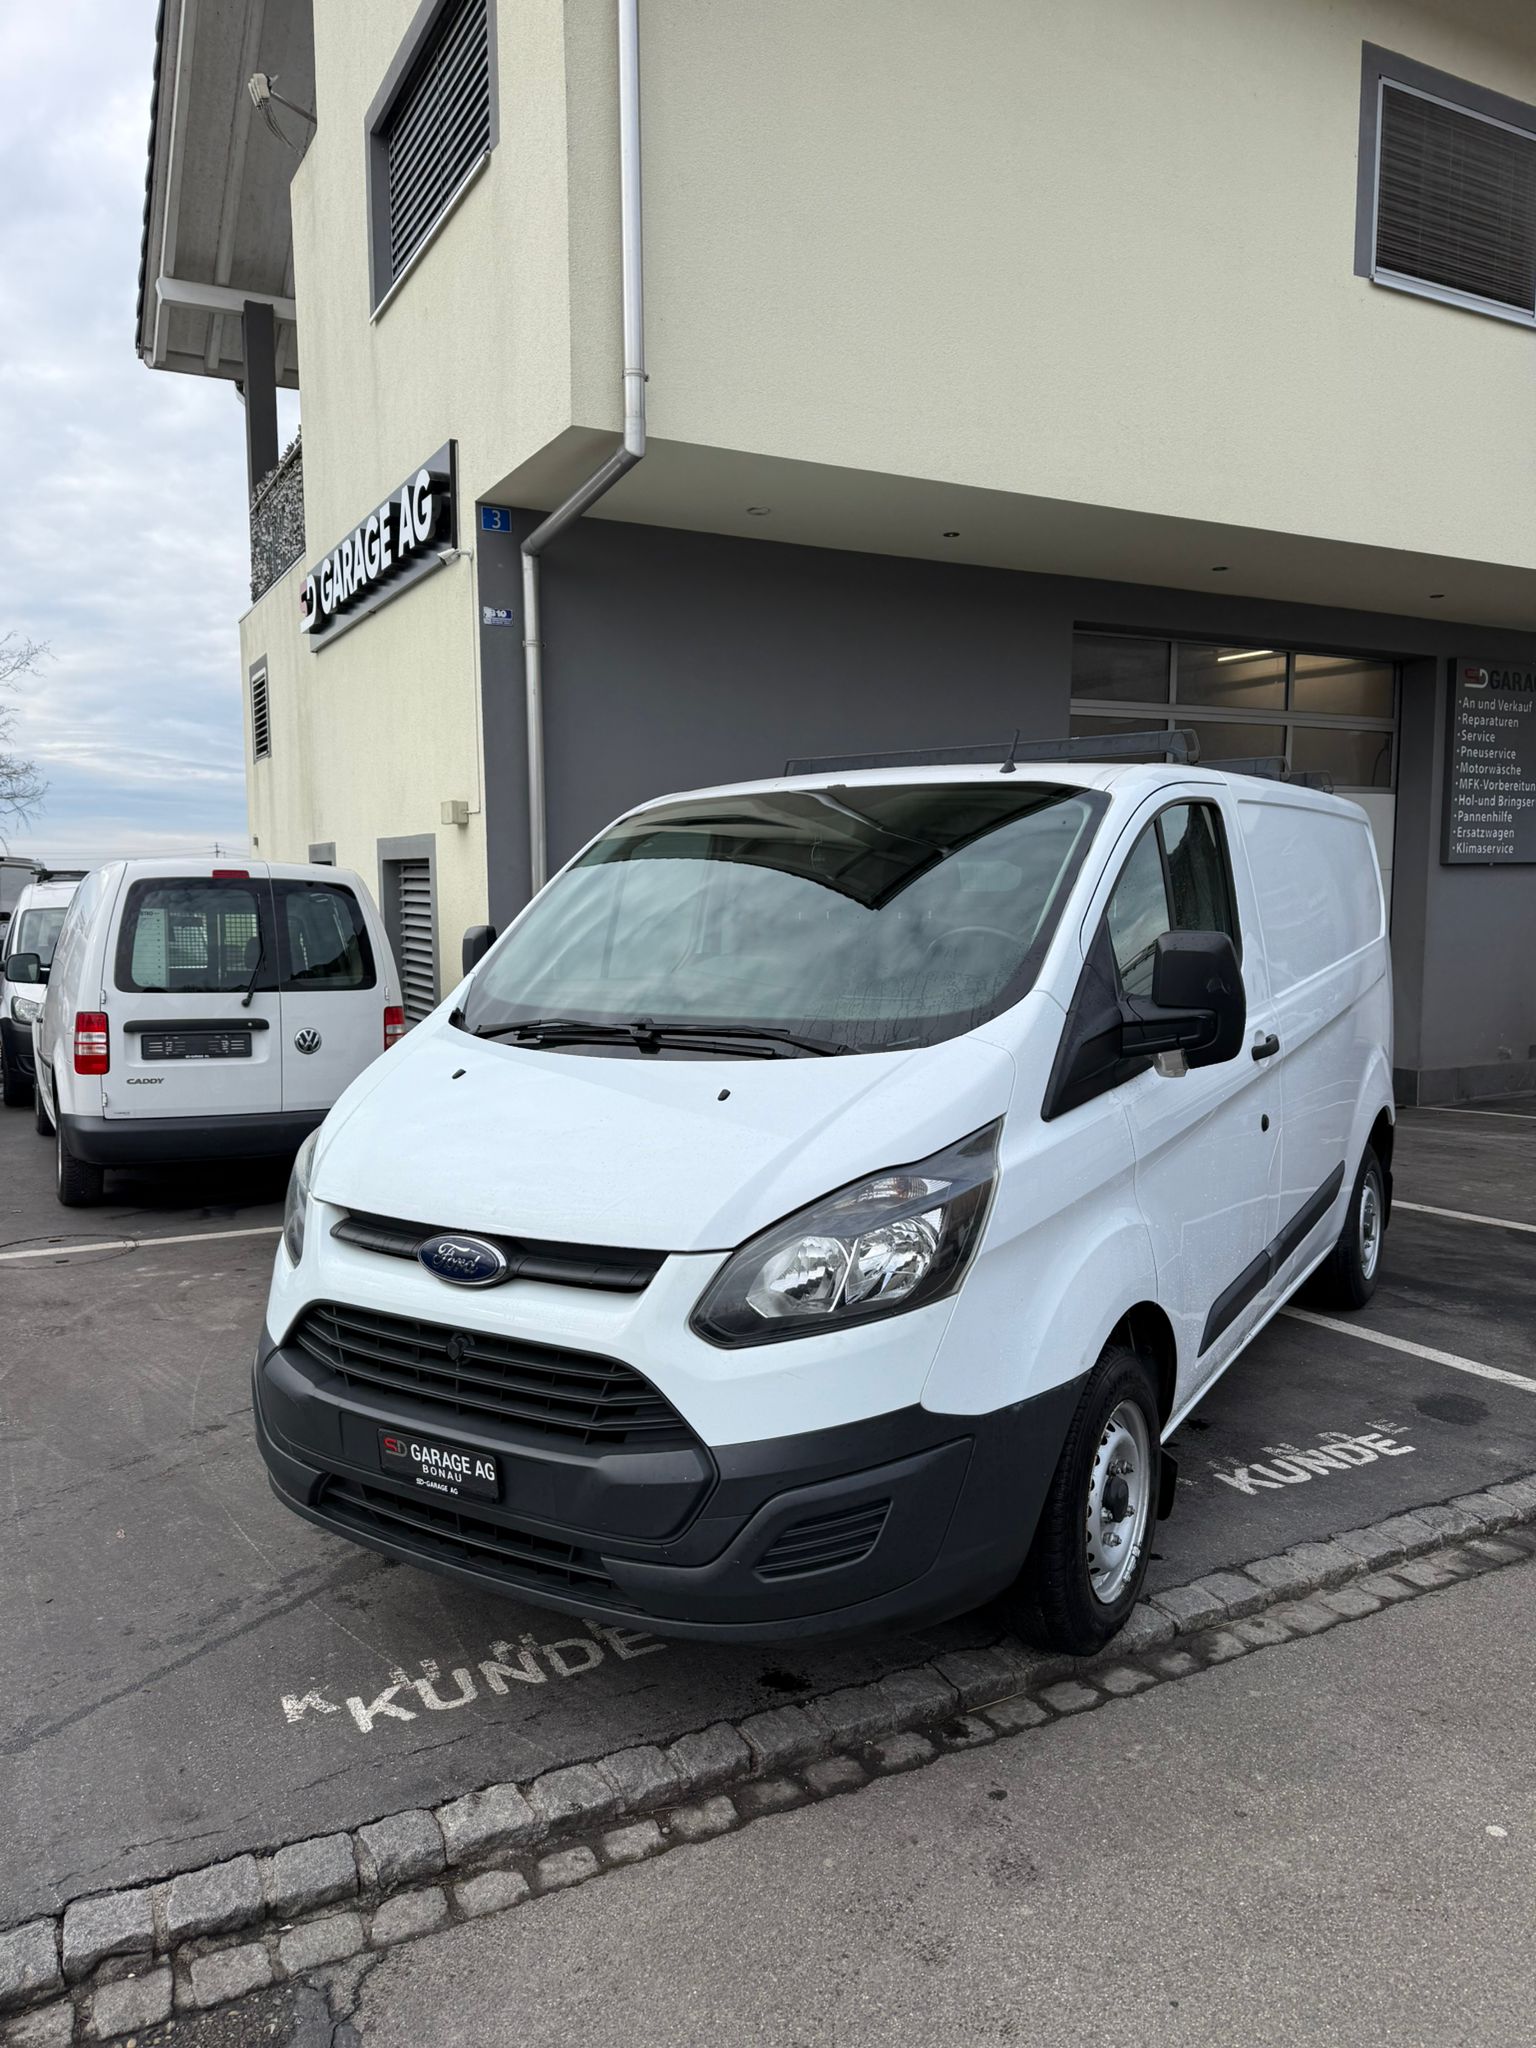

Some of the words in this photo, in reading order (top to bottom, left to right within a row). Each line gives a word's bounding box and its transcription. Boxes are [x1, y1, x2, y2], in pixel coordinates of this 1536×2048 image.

[491, 509, 502, 529] 3
[320, 501, 392, 615] GARAGE
[398, 468, 432, 558] AG
[1490, 670, 1536, 692] GARA
[1463, 697, 1476, 709] An
[1478, 699, 1496, 710] und
[1498, 700, 1533, 712] Verkauf
[1462, 713, 1519, 728] Reparaturen
[1461, 729, 1496, 743] Service
[1460, 745, 1517, 760] Pneuservice
[1460, 762, 1522, 776] Motorwäsche
[1457, 810, 1513, 823] Pannenhilfe
[1456, 826, 1515, 841] Ersatzwagen
[1456, 842, 1514, 854] Klimaservice
[433, 1242, 481, 1274] Ford
[384, 1437, 408, 1458] SD
[410, 1443, 472, 1475] GARAGE
[475, 1460, 496, 1481] AG
[1213, 1432, 1417, 1496] KUNDE
[422, 1463, 462, 1483] BONAU
[415, 1477, 449, 1493] SD-GARAGE
[450, 1486, 459, 1496] AG
[345, 1620, 668, 1734] KUNDE
